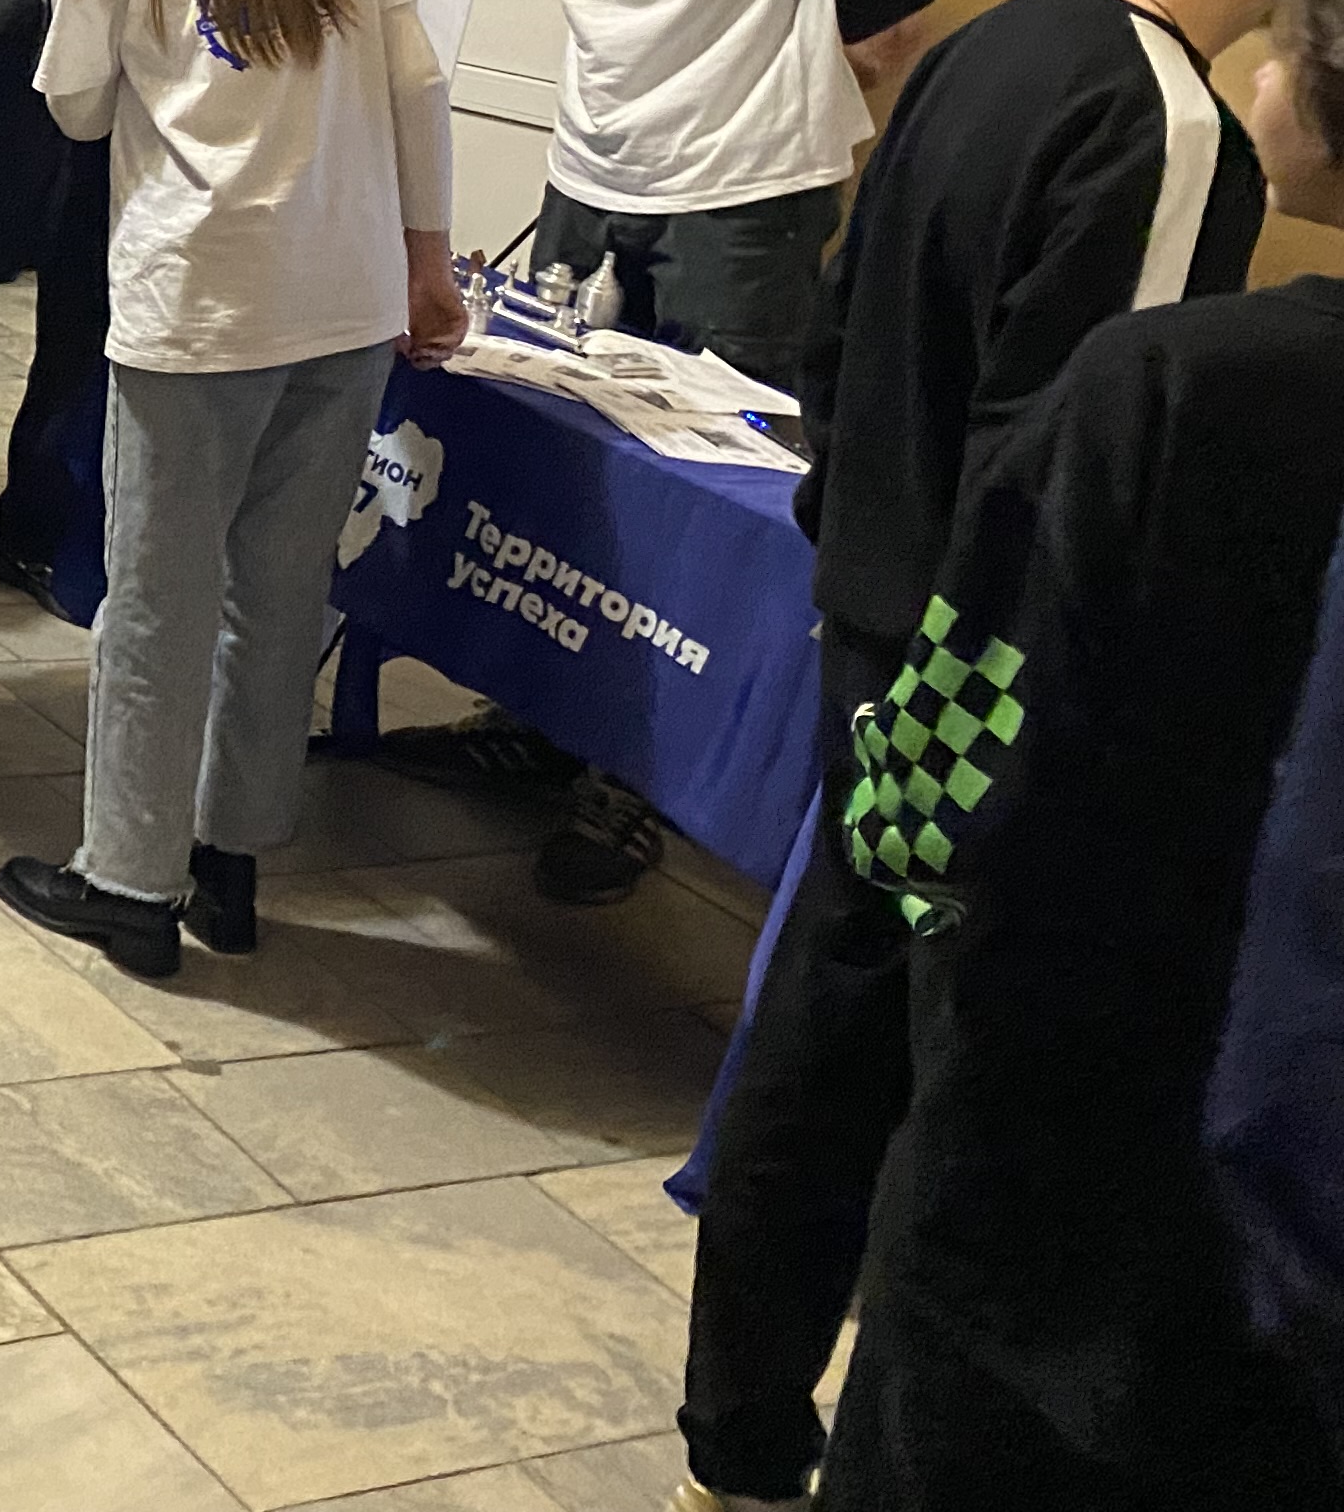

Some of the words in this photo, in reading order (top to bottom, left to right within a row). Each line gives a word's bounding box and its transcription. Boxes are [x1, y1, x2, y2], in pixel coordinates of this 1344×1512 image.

[353, 480, 378, 513] 7
[367, 450, 424, 492] ИОН
[447, 551, 590, 652] успеха
[465, 500, 710, 675] Территория
